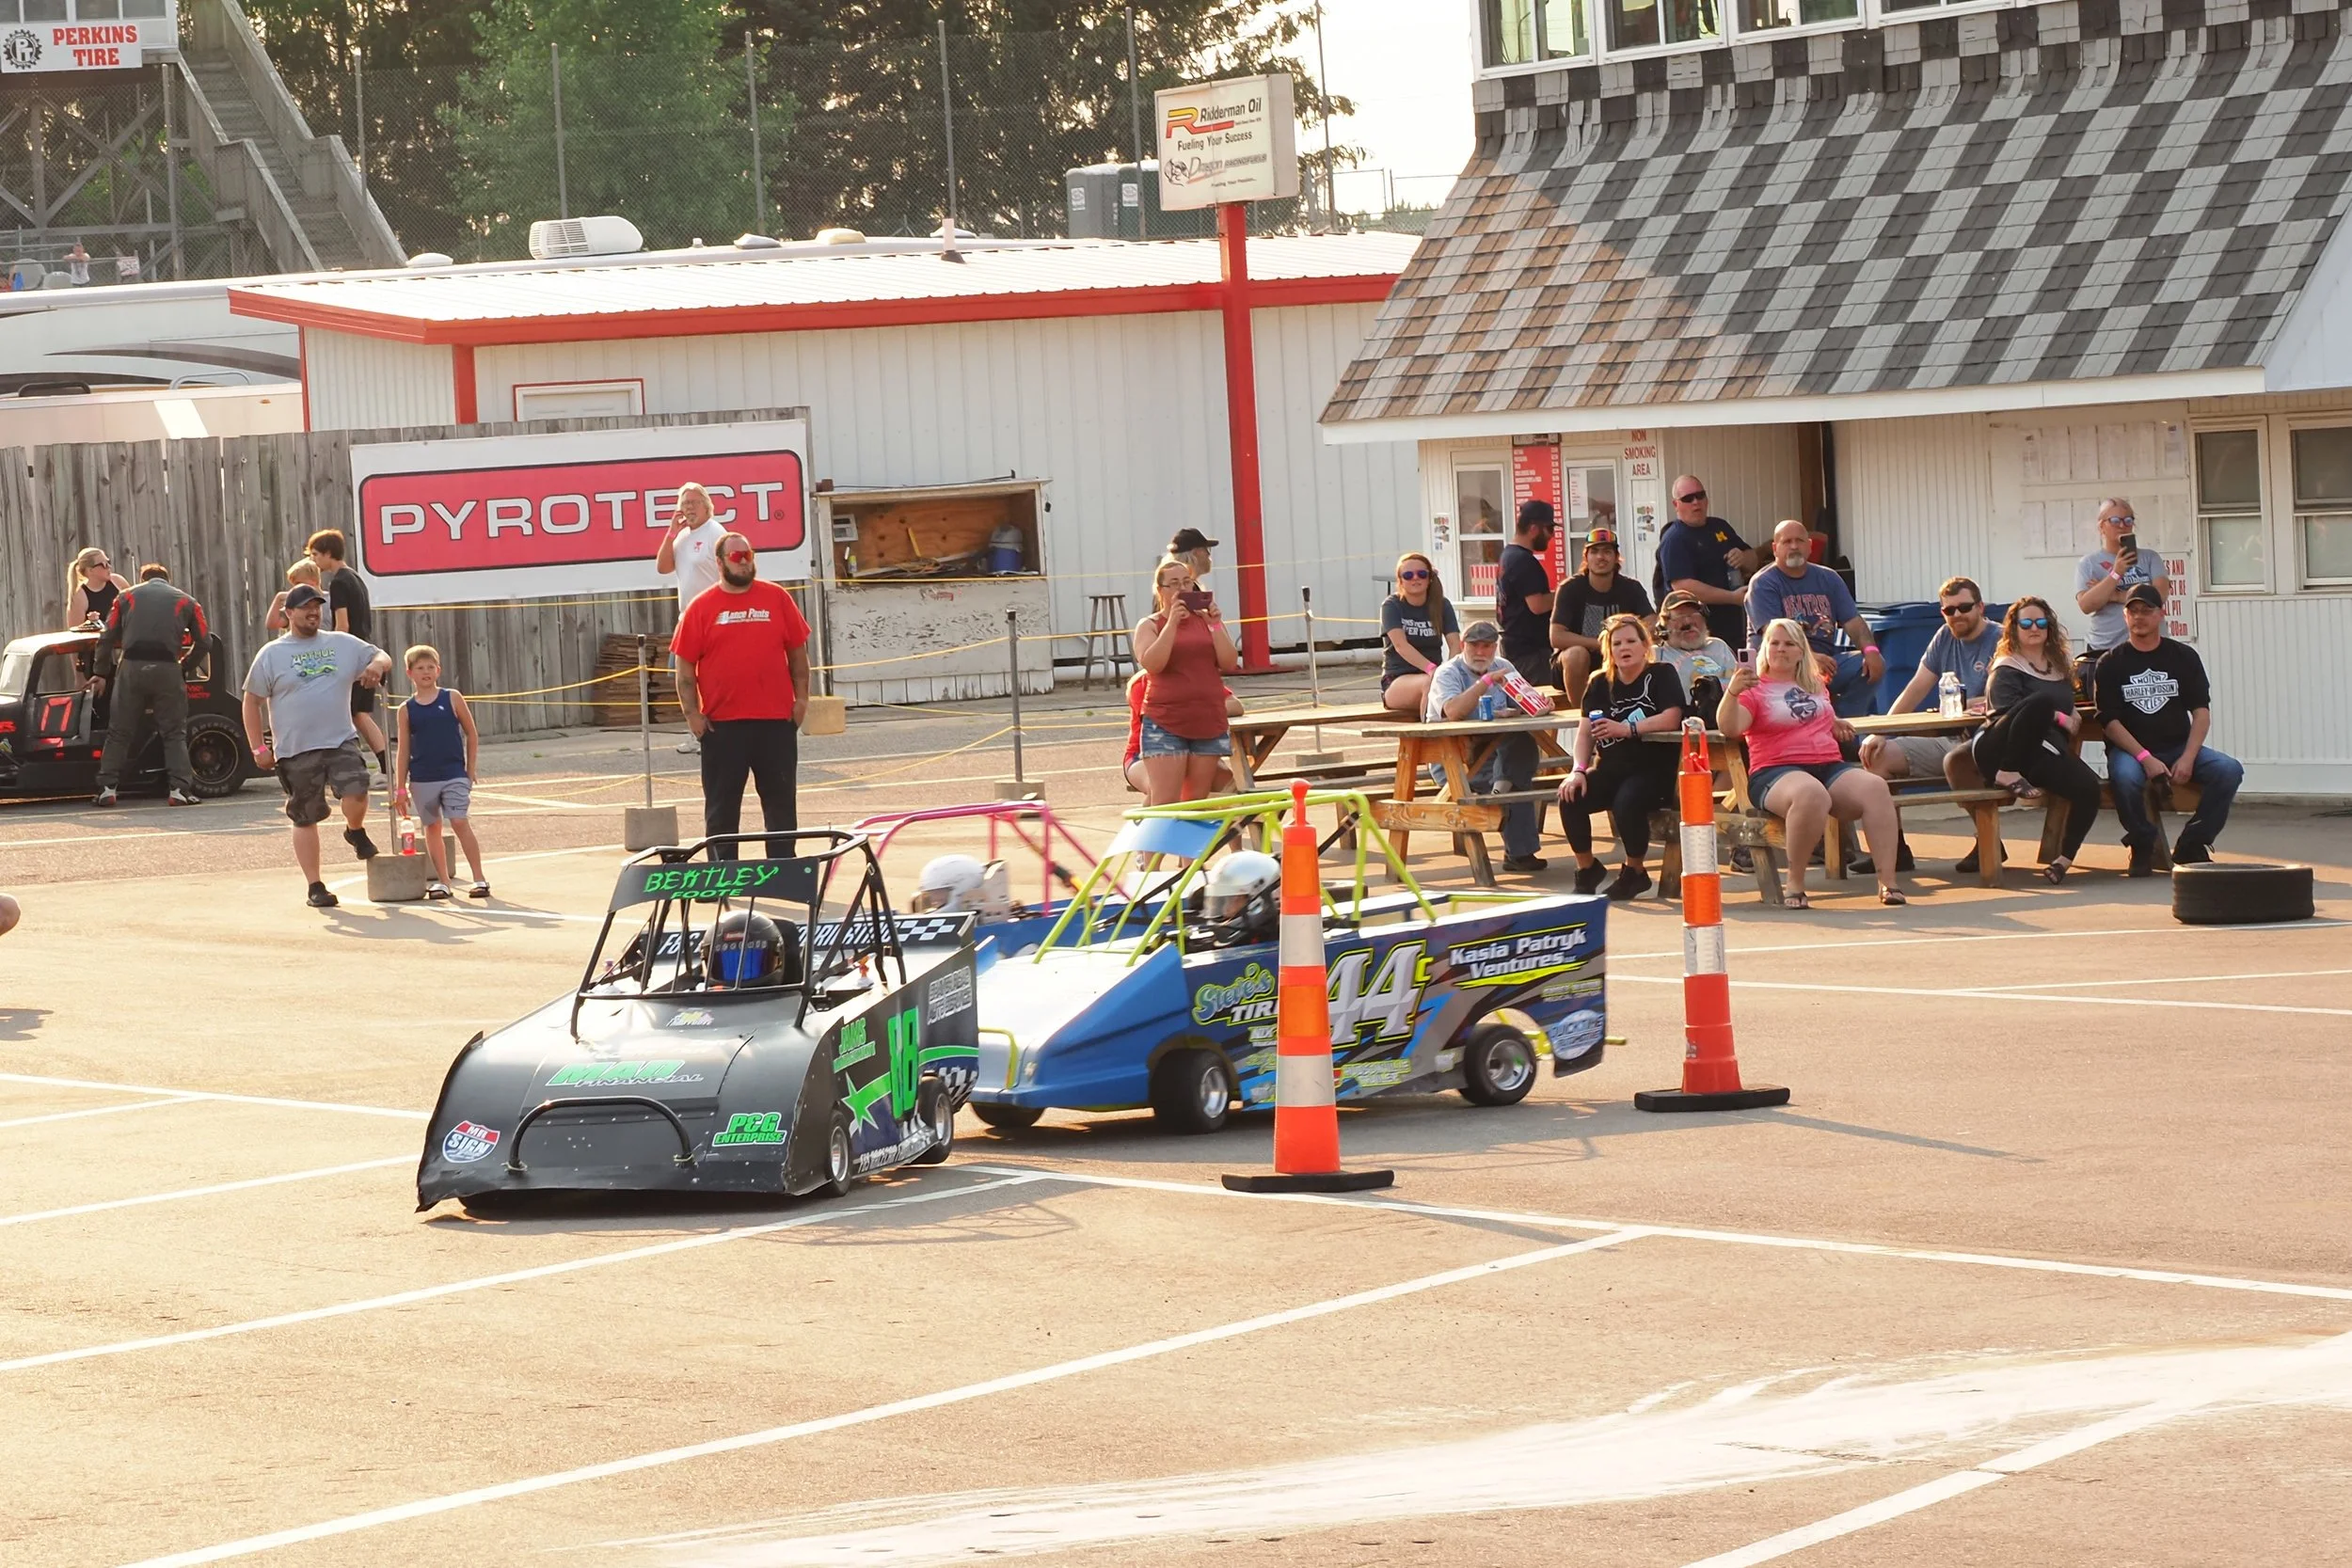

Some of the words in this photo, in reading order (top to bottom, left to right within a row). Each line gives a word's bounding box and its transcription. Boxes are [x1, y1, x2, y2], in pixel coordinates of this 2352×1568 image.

[53, 25, 137, 45] PERKINS
[72, 48, 119, 67] TIRE
[1200, 103, 1246, 123] Ridderman
[1248, 97, 1263, 113] Oil
[1177, 138, 1205, 151] Fueling
[1207, 135, 1223, 147] Your
[1225, 131, 1253, 144] Success
[1630, 429, 1647, 442] NON
[1624, 445, 1656, 460] SMOKING
[1632, 463, 1651, 476] AREA
[380, 482, 785, 546] PYROTECT
[2171, 560, 2185, 575] AND
[2137, 673, 2162, 685] MOTOR
[2138, 696, 2163, 709] CYCLES
[644, 865, 779, 893] BENTLEY
[670, 888, 744, 899] FOOTE
[1450, 942, 1510, 966] Kasia
[1516, 928, 1588, 955] Patryk
[1470, 951, 1565, 979] Ventures
[574, 1073, 705, 1087] FINANCIAL
[467, 1125, 488, 1138] MR
[713, 1132, 785, 1145] ENTERPRISE
[447, 1132, 490, 1156] SIGN
